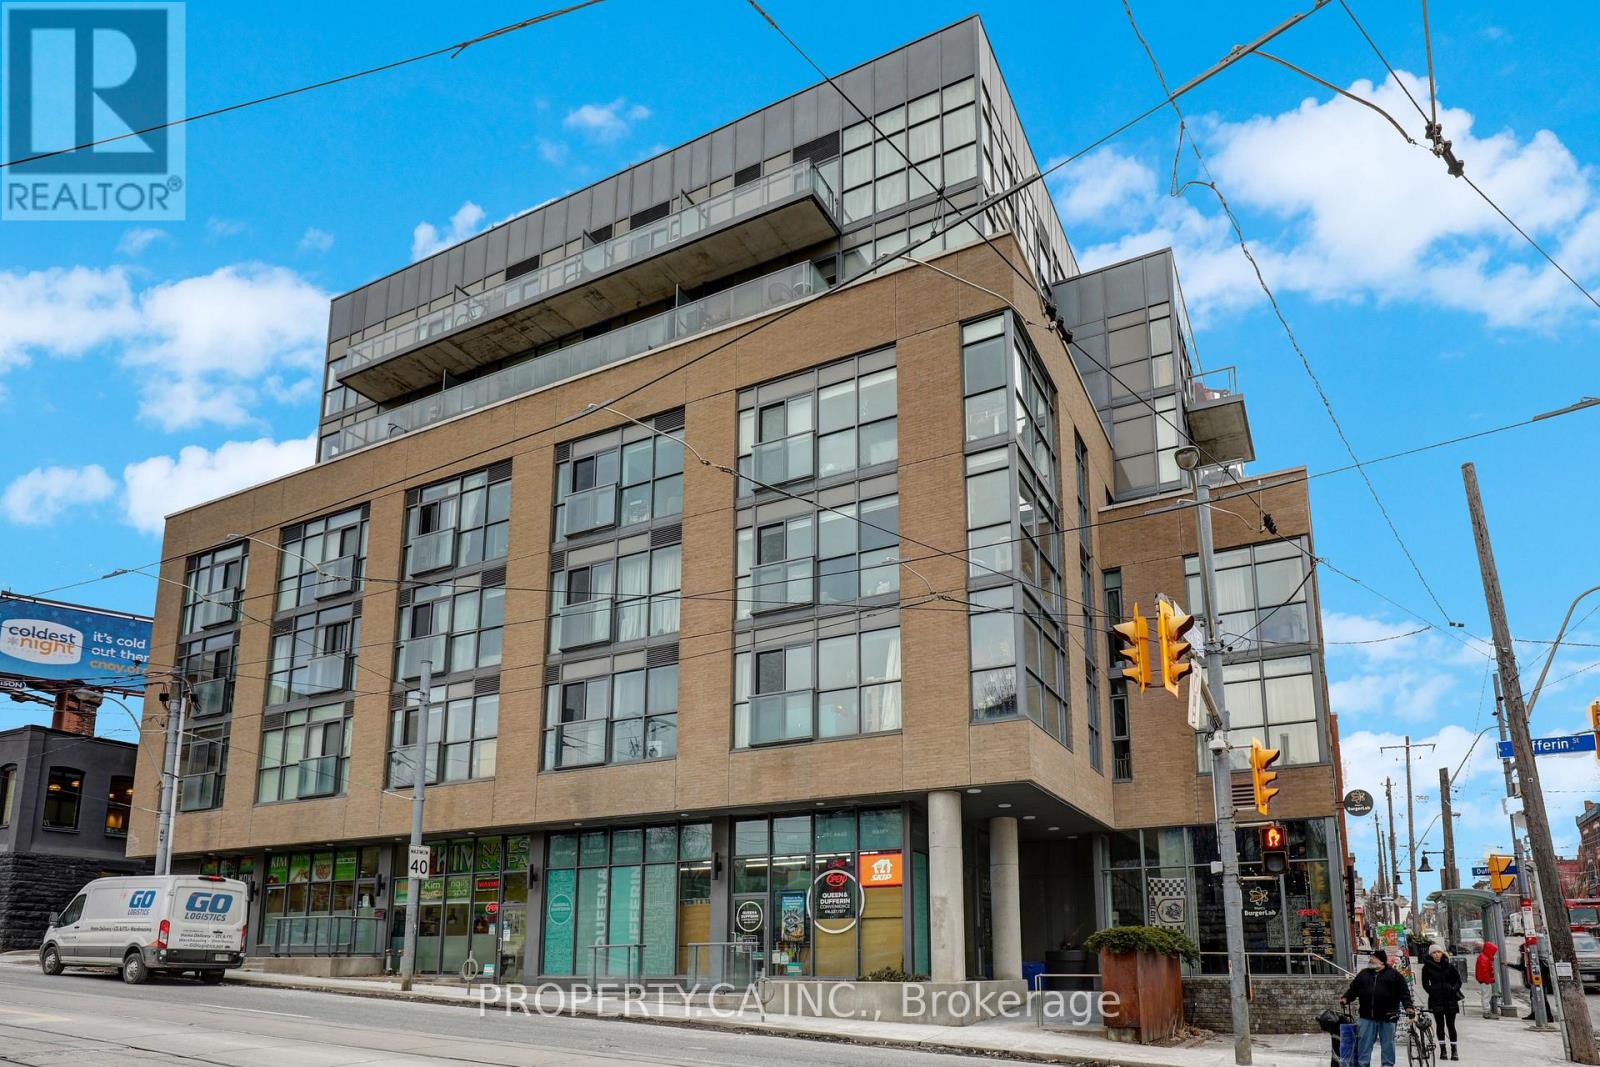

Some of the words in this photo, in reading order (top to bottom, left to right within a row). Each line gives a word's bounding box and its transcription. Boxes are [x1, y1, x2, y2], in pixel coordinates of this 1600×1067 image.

[9, 626, 76, 645] coldest
[93, 631, 113, 645] it's
[116, 637, 146, 649] cold
[20, 637, 74, 656] night
[91, 647, 116, 659] out
[120, 650, 150, 663] ther
[1532, 738, 1569, 752] fferin
[483, 840, 529, 855] NALS
[410, 859, 428, 875] 40
[871, 873, 892, 881] SKIP
[129, 890, 156, 909] GO
[185, 892, 234, 914] GO
[127, 908, 150, 916] LOGISTICS
[184, 911, 227, 922] LOGISTICS
